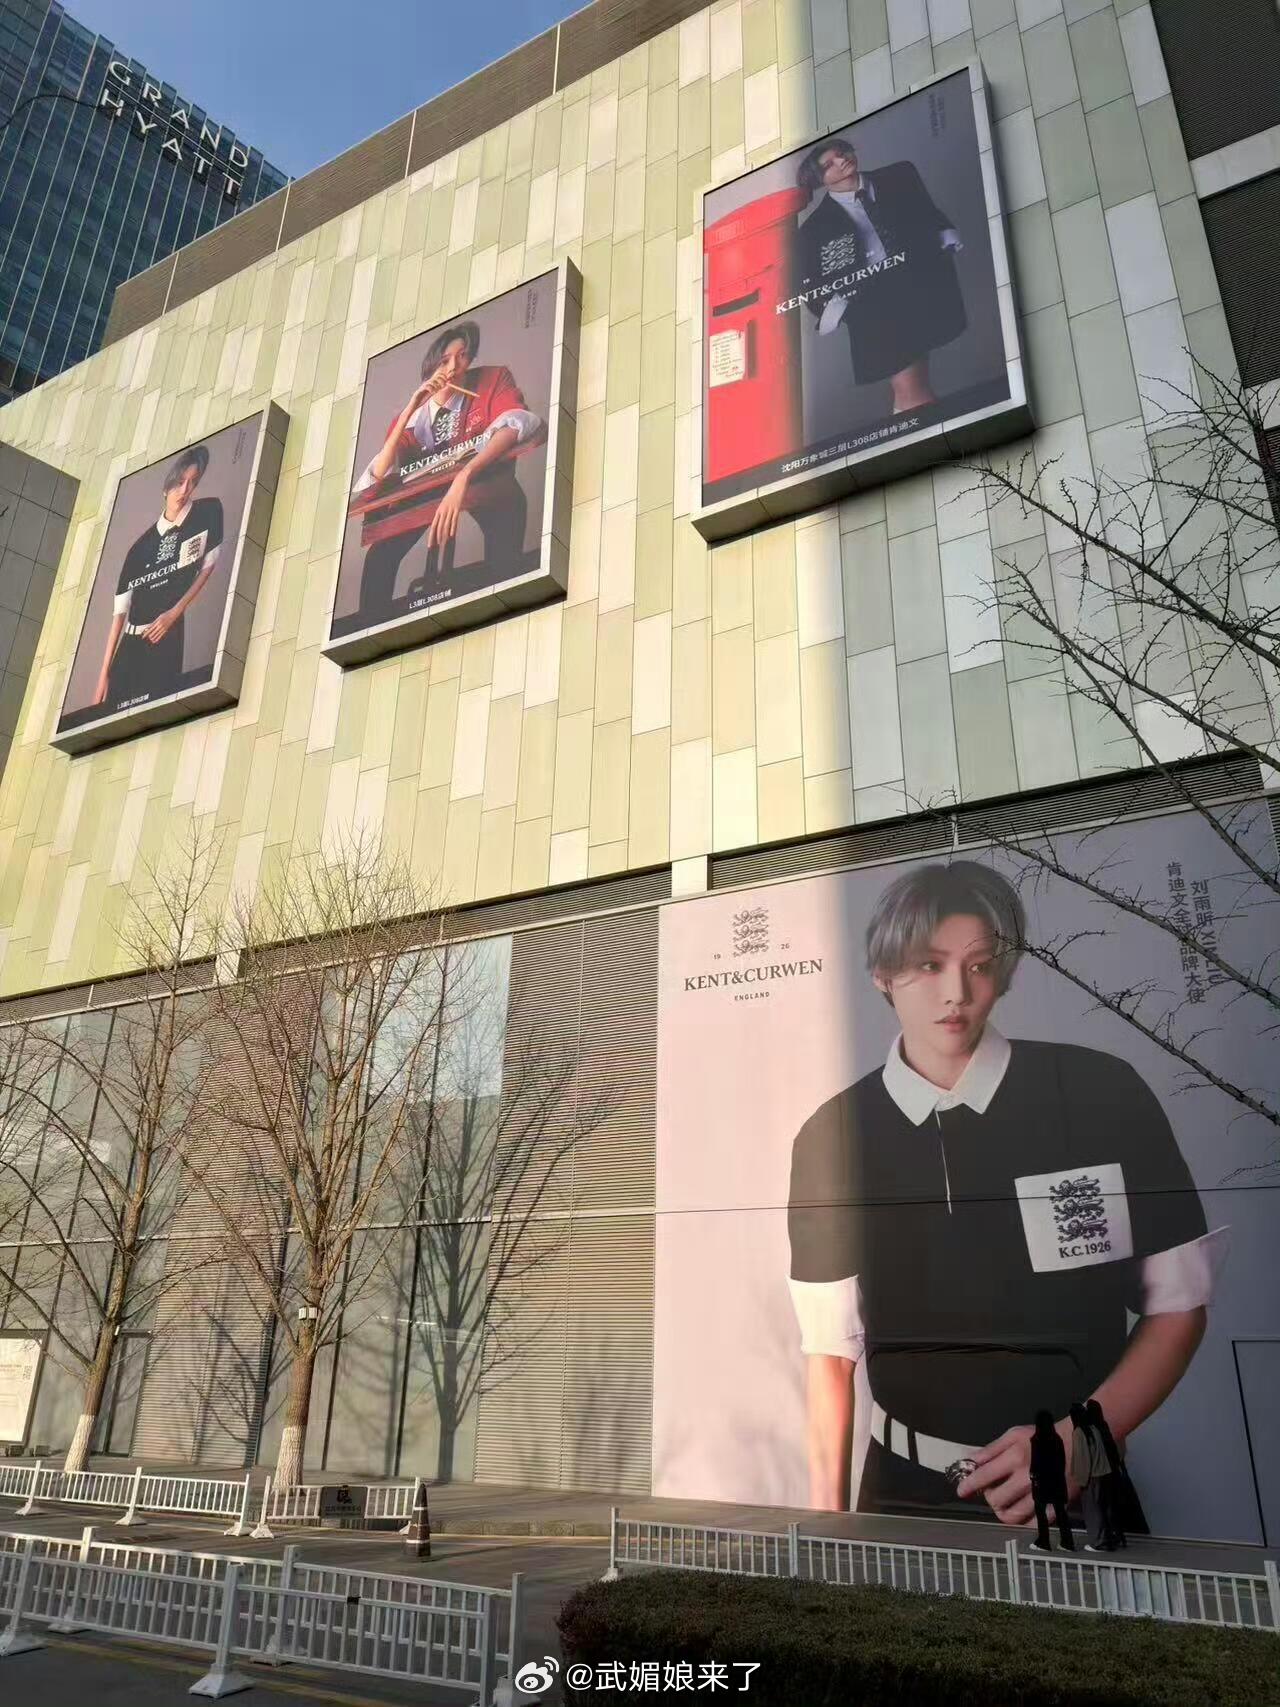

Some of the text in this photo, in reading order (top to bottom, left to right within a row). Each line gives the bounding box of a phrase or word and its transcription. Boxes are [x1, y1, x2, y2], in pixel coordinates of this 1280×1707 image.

[109, 61, 248, 168] GRAND
[101, 88, 242, 194] HYATT
[775, 251, 906, 315] KENT&CURWEN
[399, 431, 492, 477] KENT&CURWEN
[127, 556, 200, 590] KENT&CUR
[684, 958, 824, 992] KENT&CURWEN
[734, 991, 771, 1001] ENGLAND
